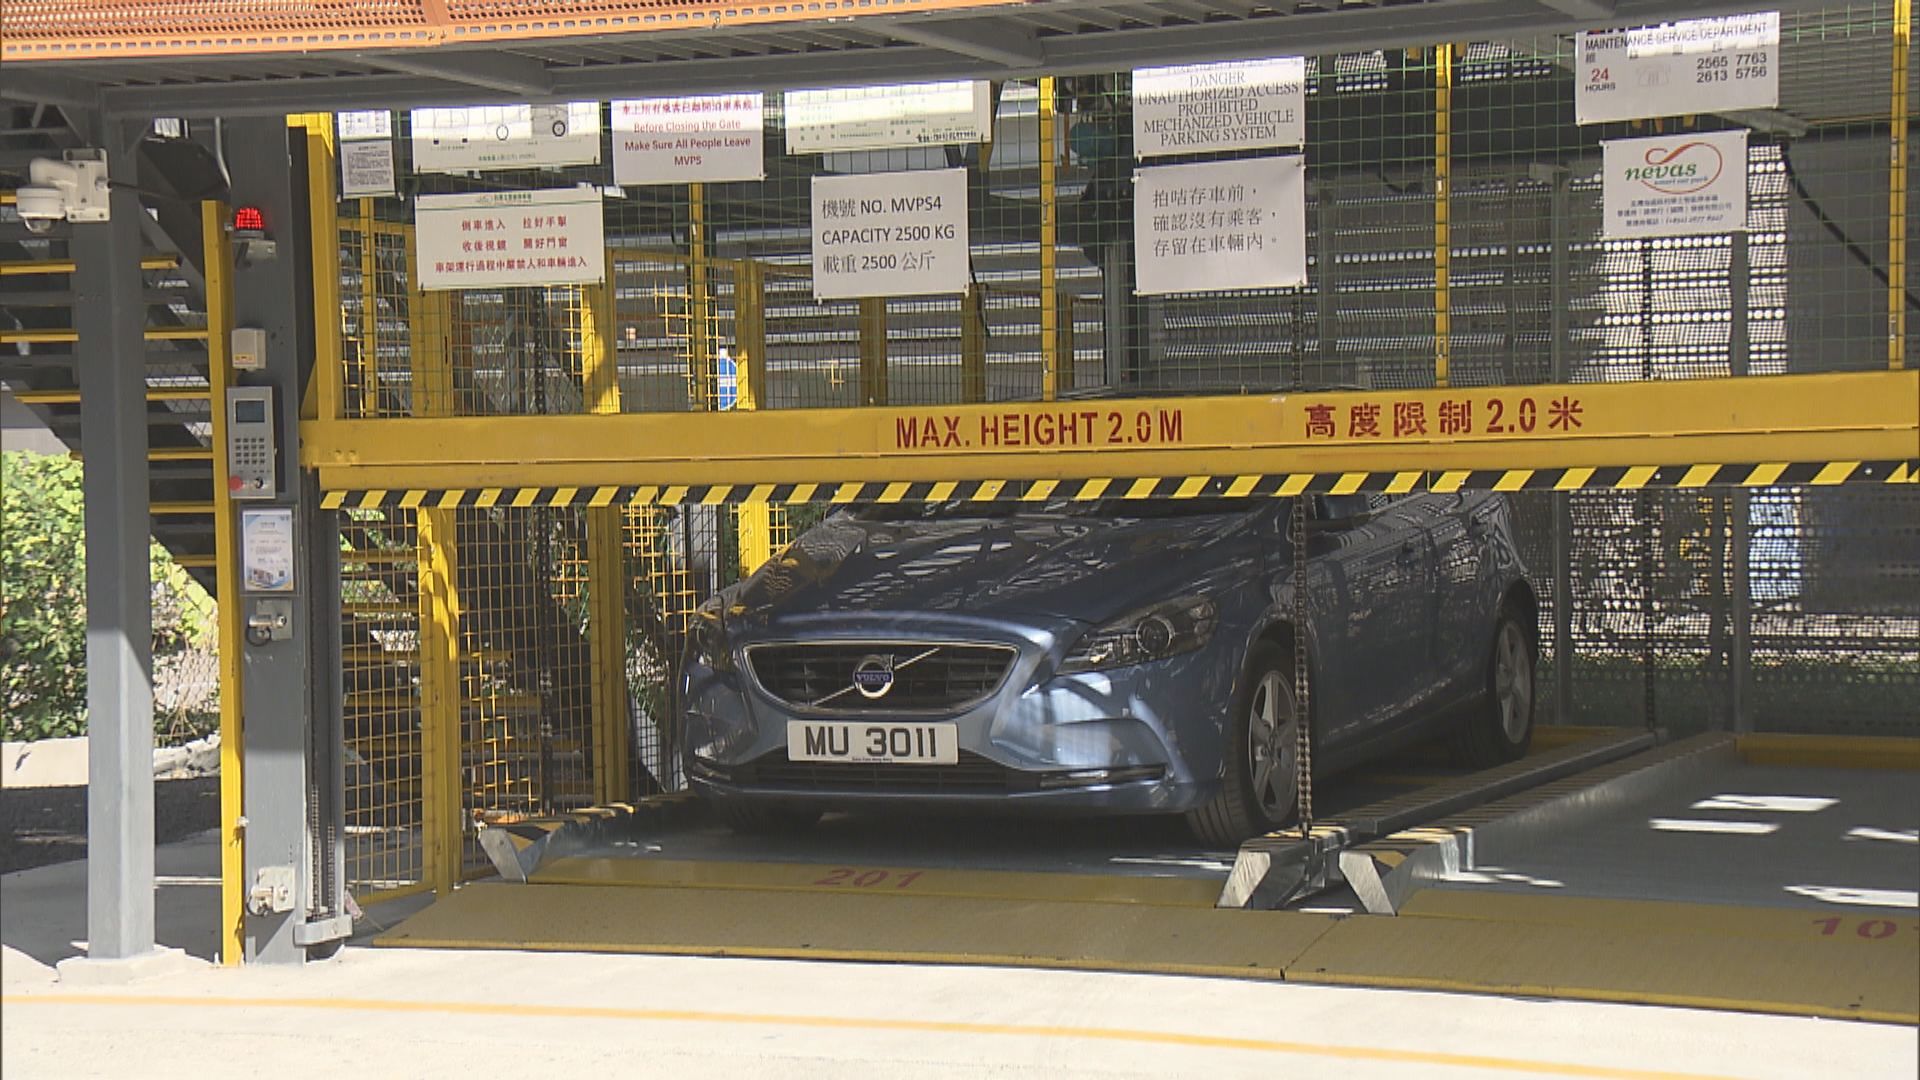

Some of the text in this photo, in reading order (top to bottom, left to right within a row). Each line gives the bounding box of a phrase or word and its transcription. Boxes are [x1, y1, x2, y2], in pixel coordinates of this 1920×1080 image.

[1585, 34, 1653, 51] MAINTENANCE
[1656, 29, 1698, 44] SERVICE
[1701, 22, 1767, 39] DEPARTMENT
[1697, 52, 1767, 70] 2565 7763
[1190, 72, 1245, 87] DANGER
[1591, 67, 1609, 82] 24
[1697, 66, 1767, 83] 2613 5756
[1139, 82, 1298, 105] UNAUTHORIZED ACCESS
[1585, 82, 1616, 92] HOURS
[1178, 99, 1258, 117] PROHIBITED
[634, 117, 741, 133] Before Closing the Gate
[1144, 109, 1294, 133] MECHANIZED VEHICLE
[625, 135, 751, 151] Make Sure All People Leave
[1161, 125, 1276, 146] PARKING SYSTEM
[674, 155, 702, 166] MVPS
[1624, 163, 1697, 181] nevas
[860, 199, 887, 215] NO.
[891, 195, 942, 214] MVPS4
[822, 223, 955, 246] CAPACITY 2500 KG
[823, 250, 936, 274] 載重 2500 公斤
[896, 415, 971, 449] MAX.
[981, 411, 1098, 446] HEIGHT
[855, 673, 891, 682] VOLVO
[805, 725, 937, 758] MU 3011
[814, 868, 925, 889] 201
[1812, 917, 1919, 939] 10
